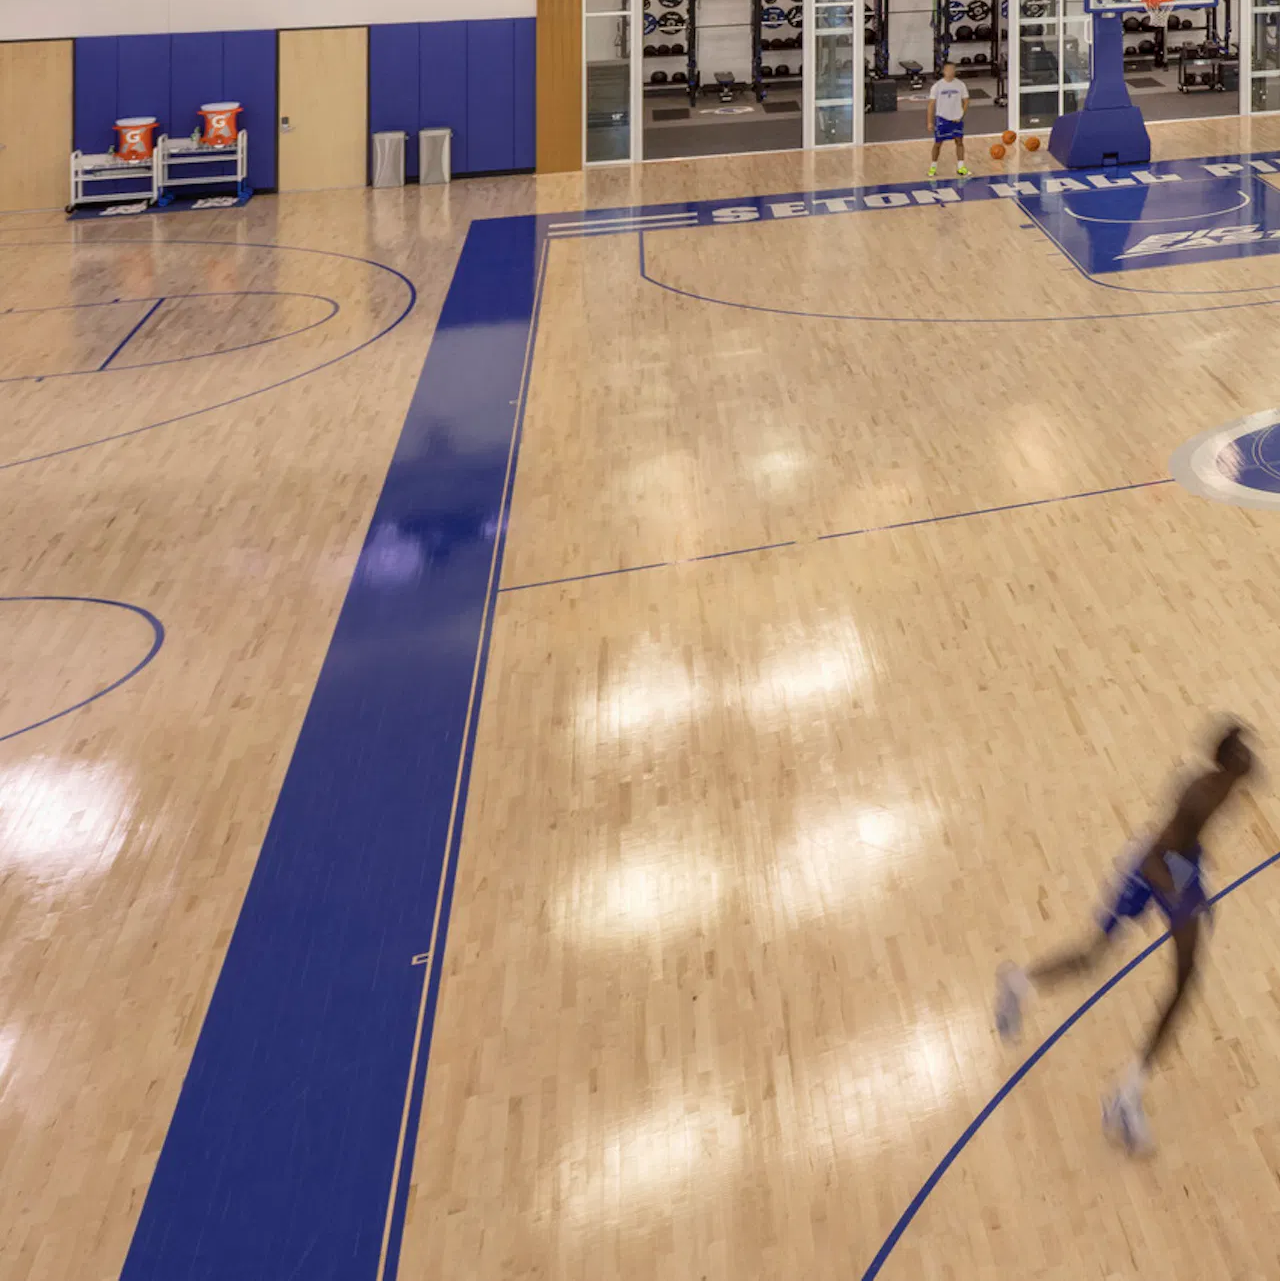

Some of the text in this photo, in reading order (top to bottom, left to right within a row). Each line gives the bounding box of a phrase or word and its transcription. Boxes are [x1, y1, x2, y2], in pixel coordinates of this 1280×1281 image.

[211, 115, 226, 128] G
[126, 130, 140, 144] G
[712, 187, 962, 223] SETON
[988, 170, 1183, 197] HALL
